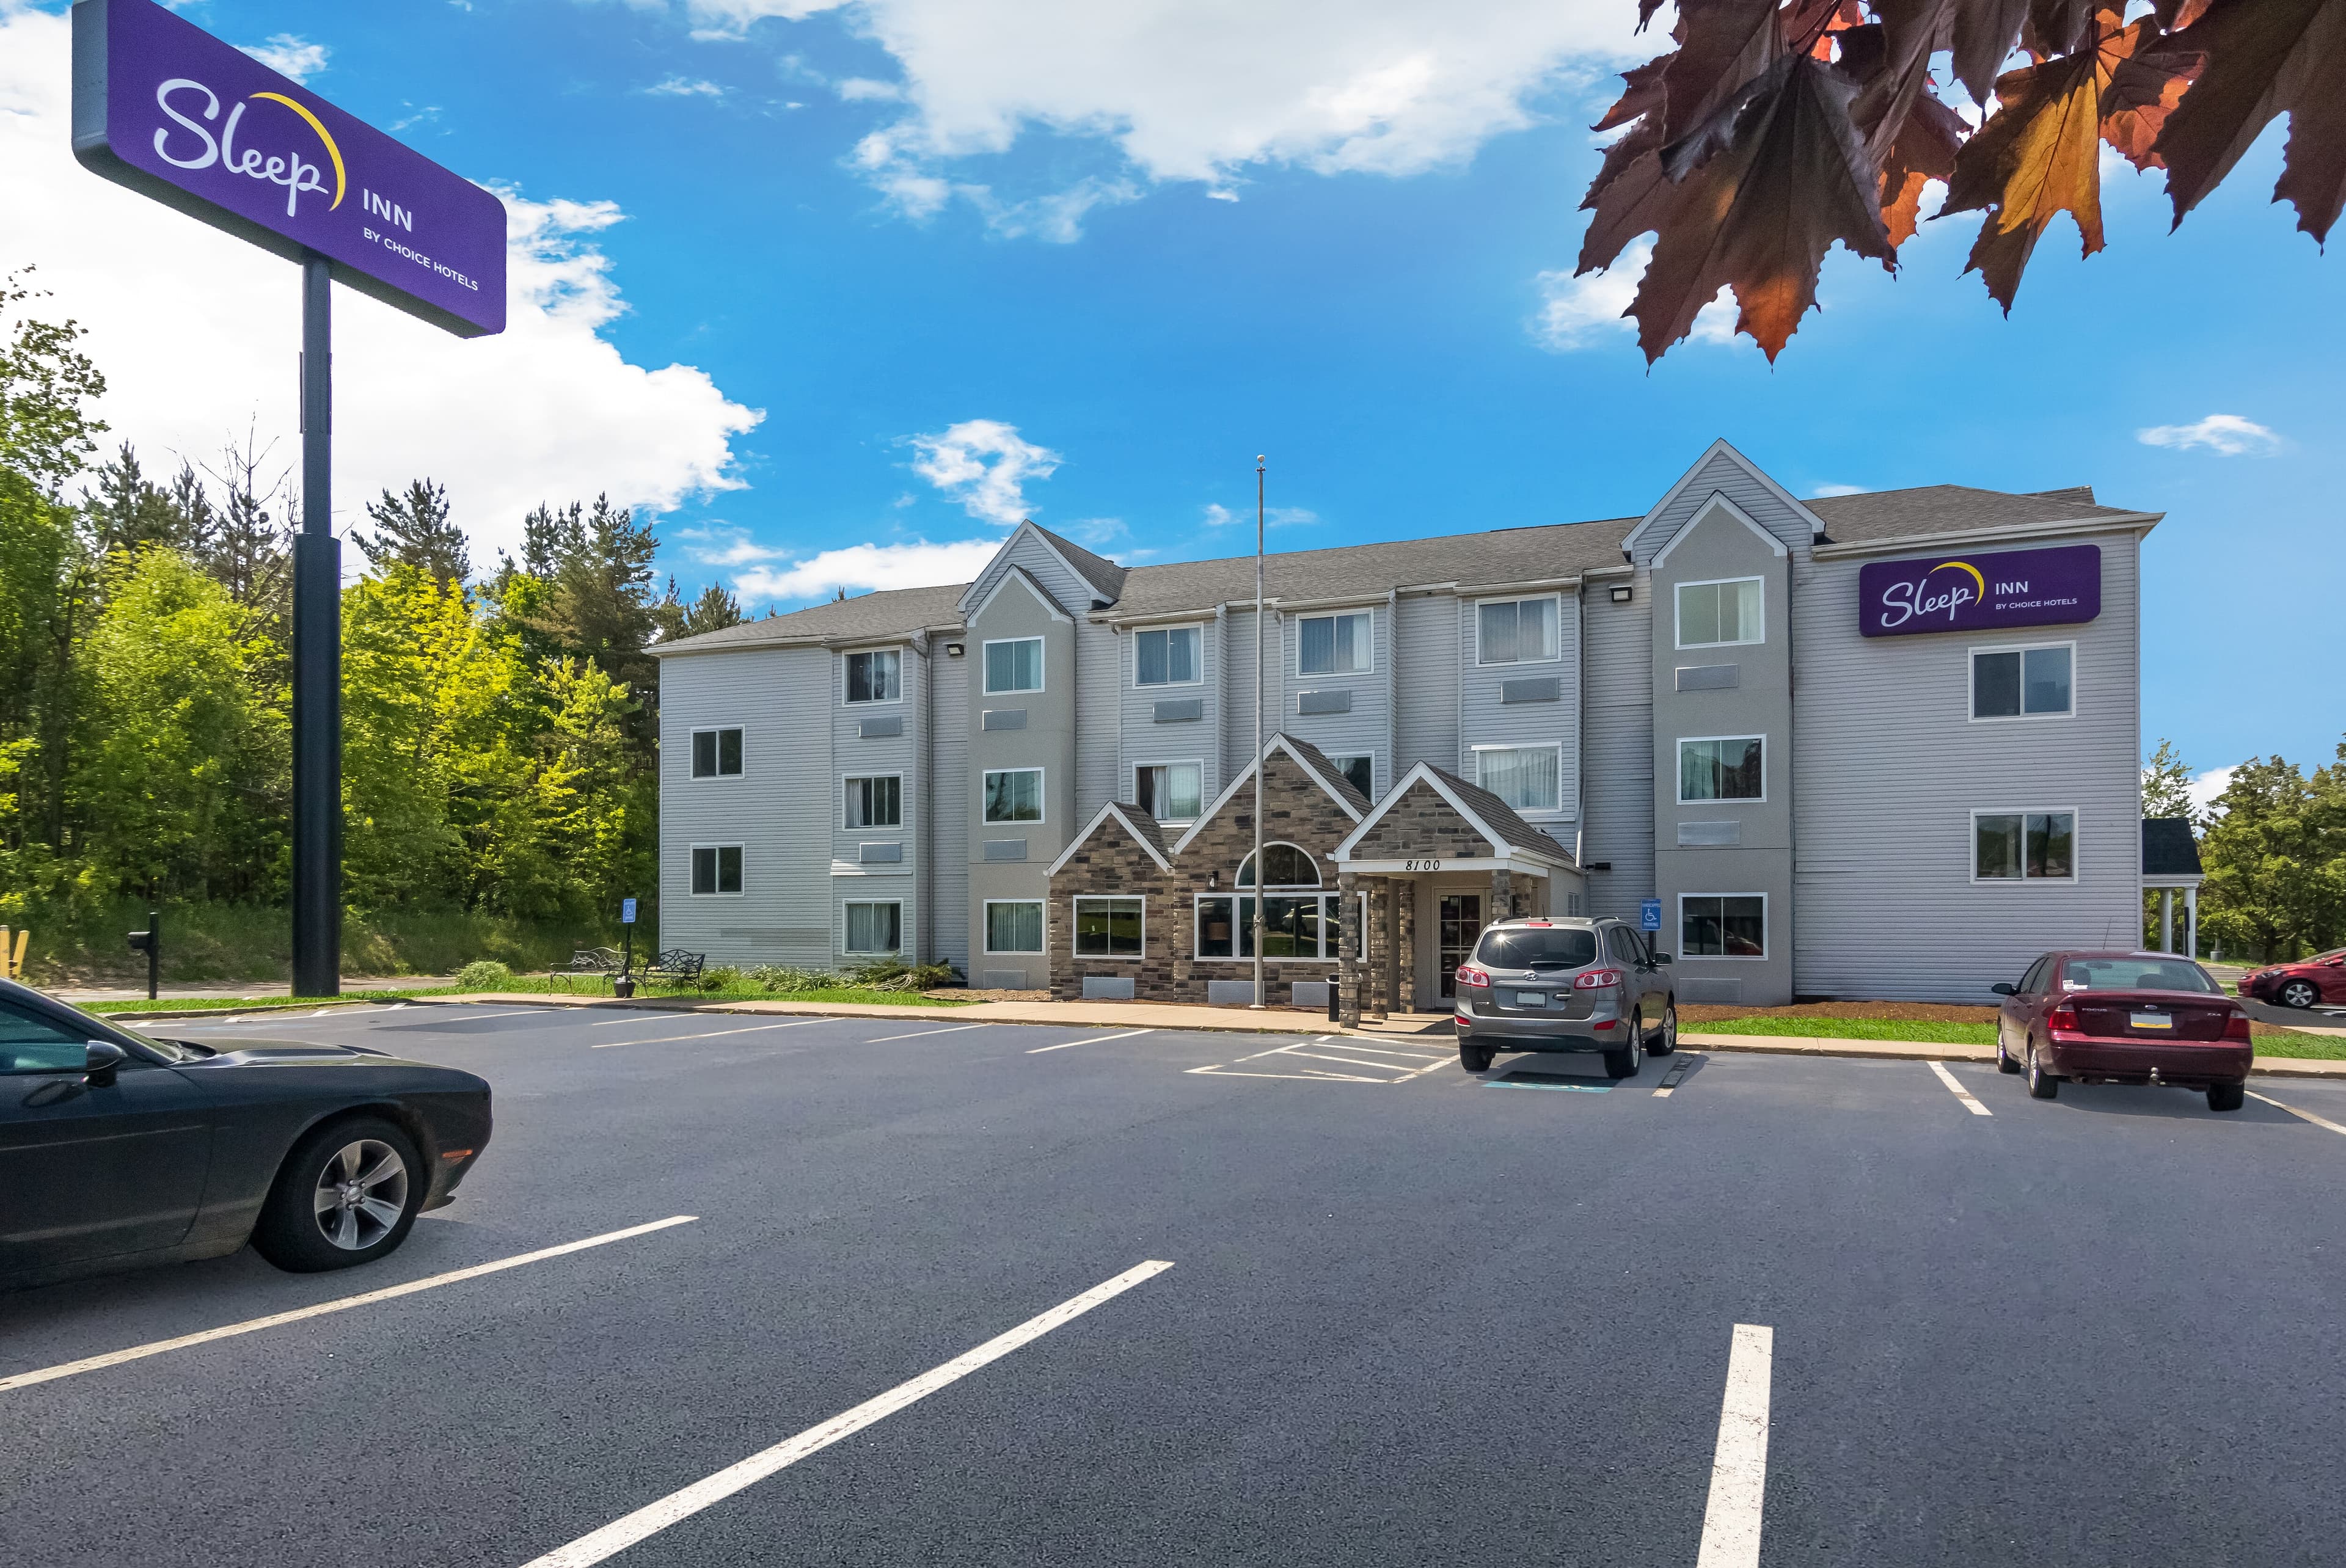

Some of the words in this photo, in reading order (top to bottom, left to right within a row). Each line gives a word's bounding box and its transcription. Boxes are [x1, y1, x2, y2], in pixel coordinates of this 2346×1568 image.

[153, 78, 329, 217] Sleep
[364, 188, 412, 232] INN
[364, 227, 381, 243] BY
[384, 238, 431, 269] CHOICE
[433, 261, 478, 291] HOTELS
[1881, 578, 1974, 627] Sleep
[1995, 581, 2029, 595] INN
[1406, 859, 1440, 871] 8100
